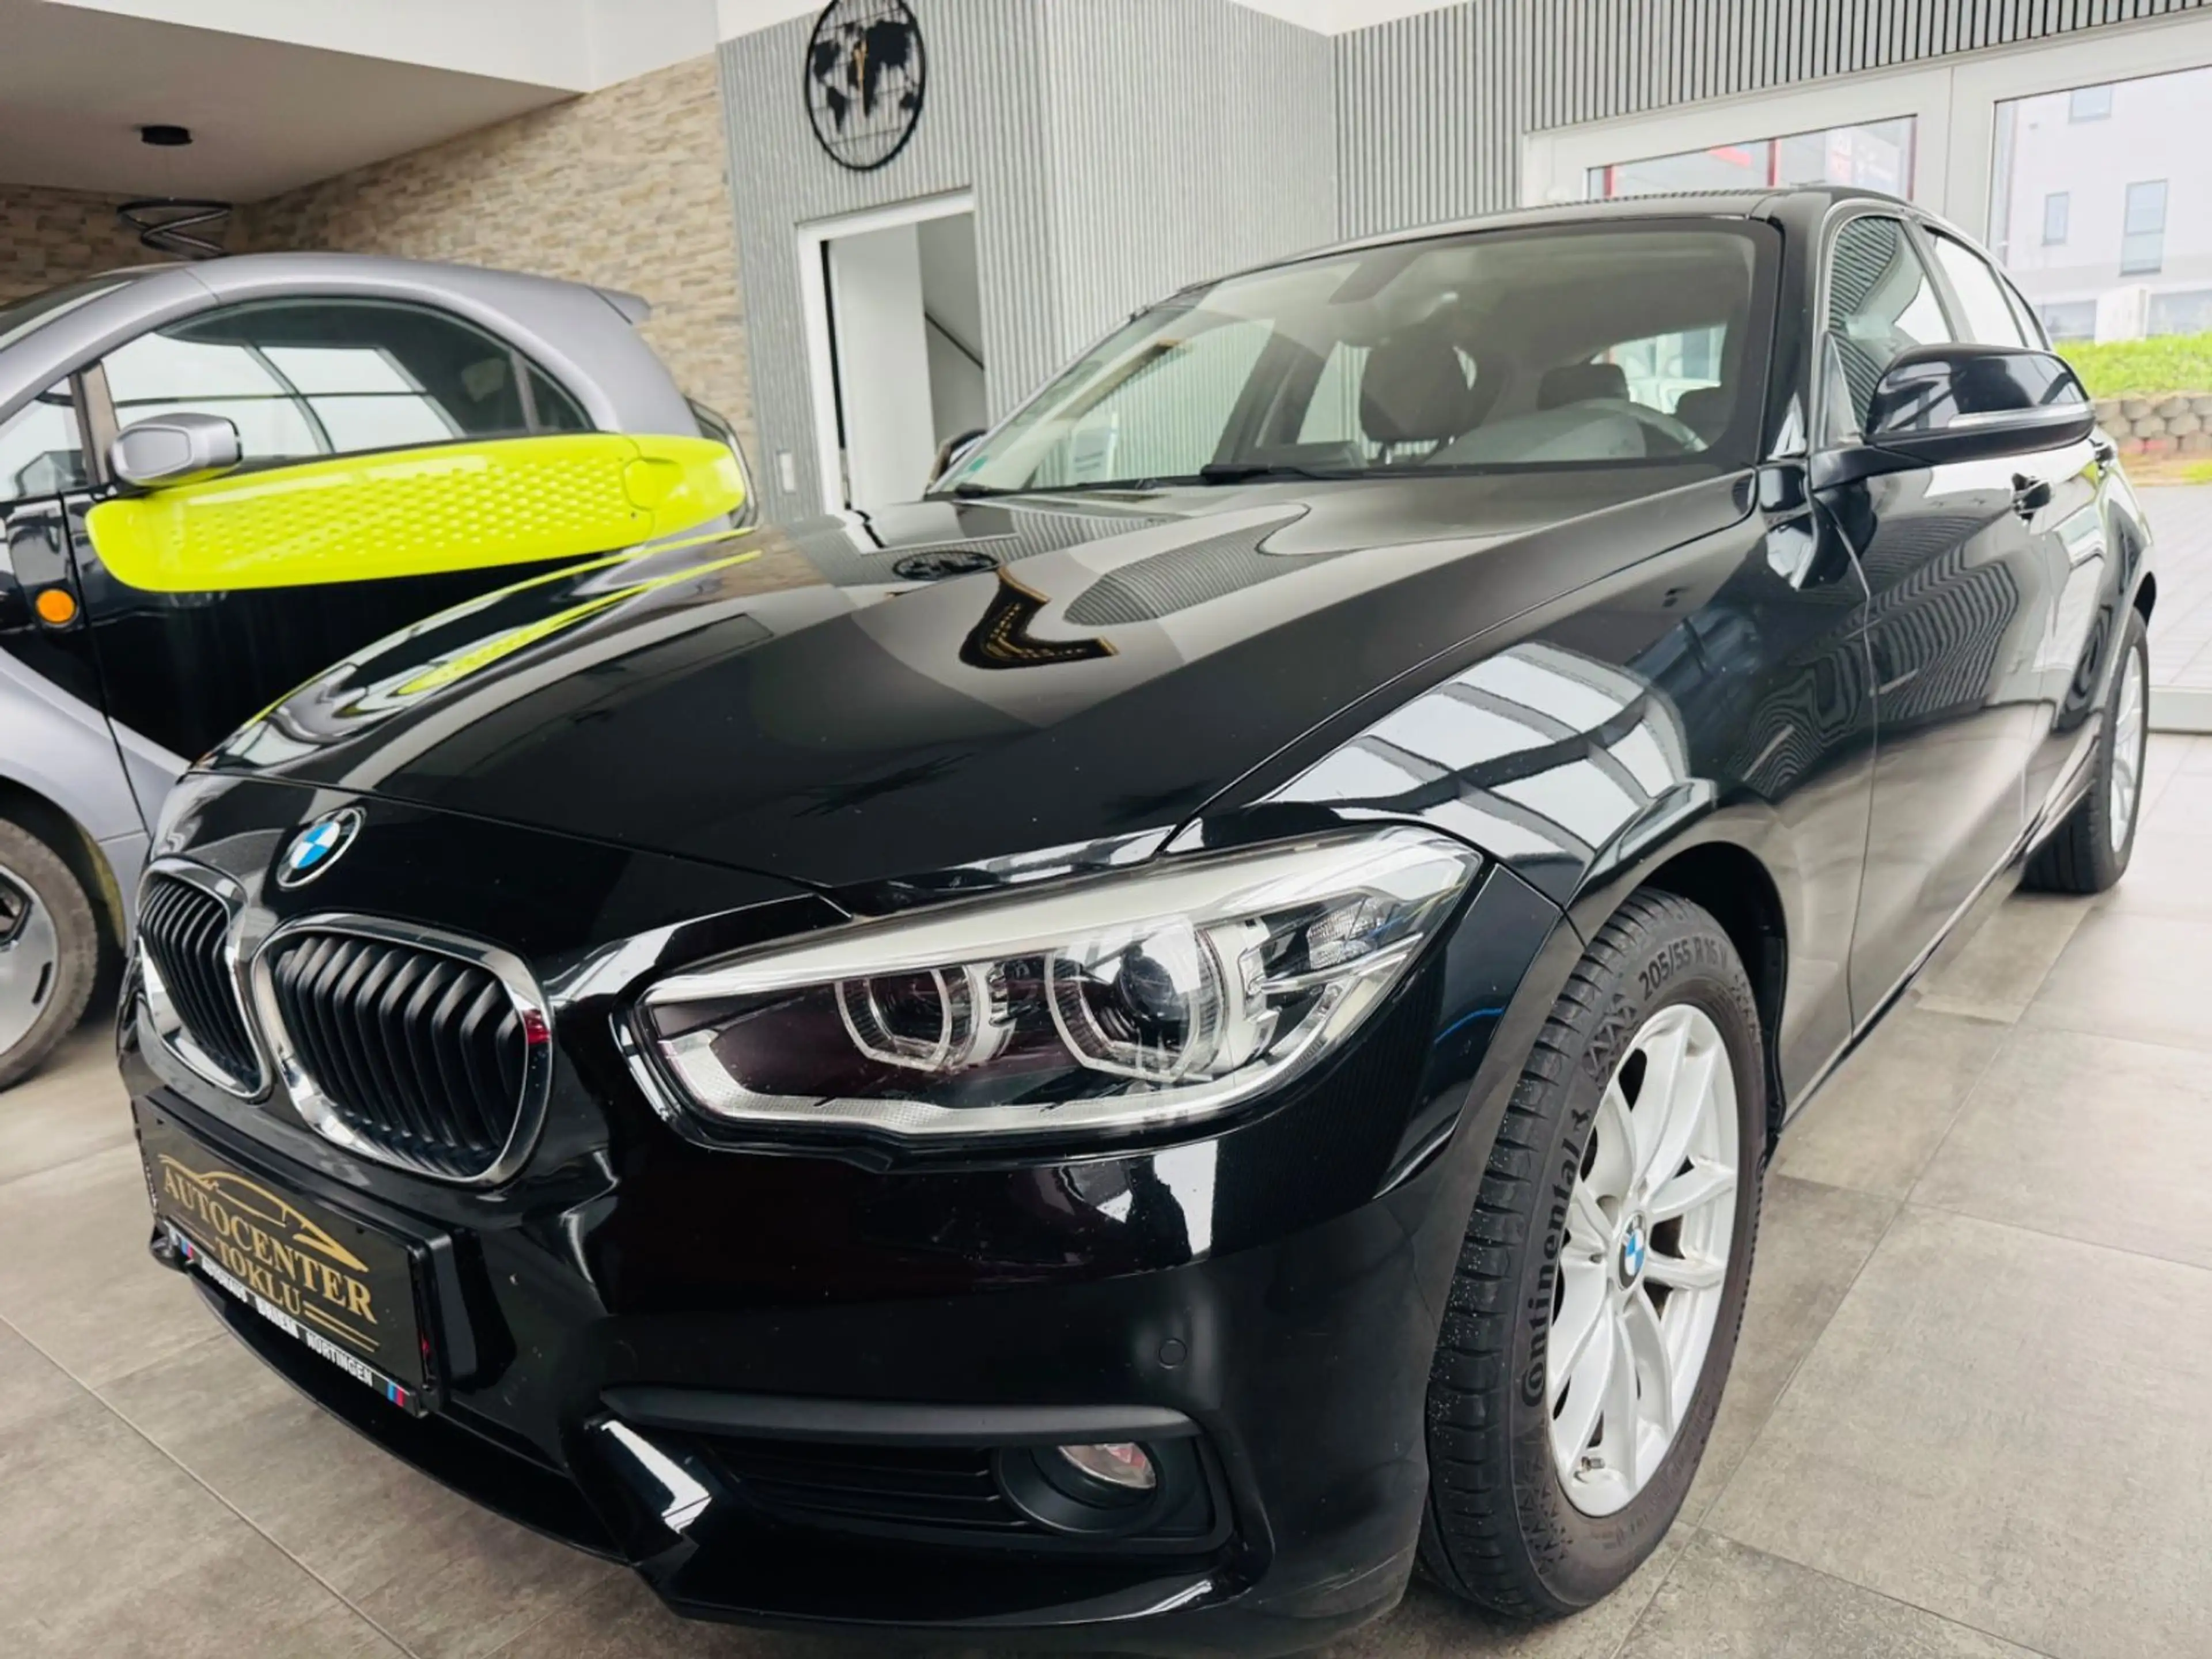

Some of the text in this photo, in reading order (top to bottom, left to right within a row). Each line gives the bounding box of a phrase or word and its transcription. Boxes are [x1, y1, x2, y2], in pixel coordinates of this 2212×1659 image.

[1638, 940, 1691, 1001] 205/55
[164, 1166, 378, 1324] AUTOCENTER
[214, 1236, 301, 1315] TOKLU
[1521, 1138, 1580, 1407] Continental
